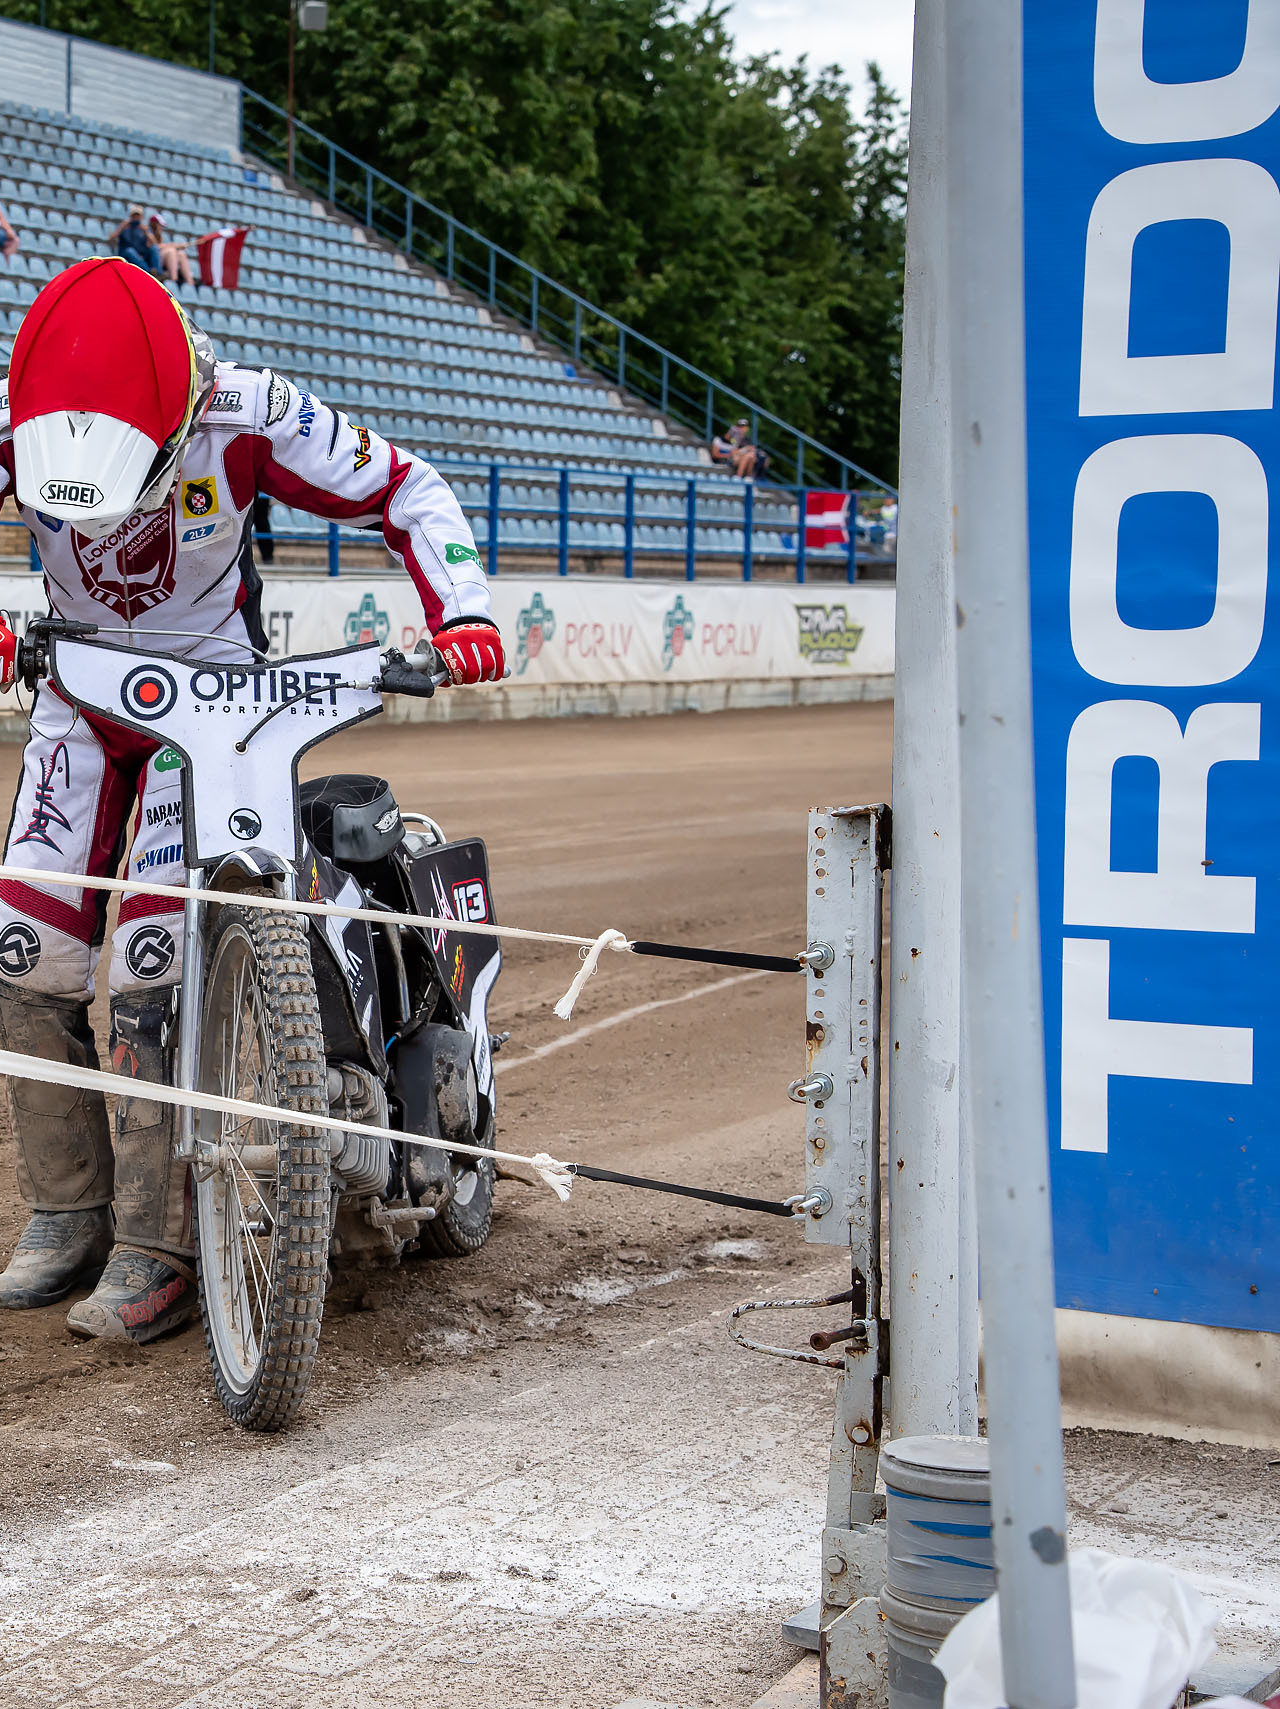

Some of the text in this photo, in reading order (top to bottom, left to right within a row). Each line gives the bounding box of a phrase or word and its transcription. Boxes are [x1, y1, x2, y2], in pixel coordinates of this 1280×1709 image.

[47, 483, 96, 505] SHOEI
[126, 513, 169, 553] DAUGAVPILS
[127, 523, 169, 561] SPEEDWAY CLUB
[189, 669, 342, 706] OPTIBET
[194, 704, 273, 715] SPORTA
[453, 883, 486, 922] 113
